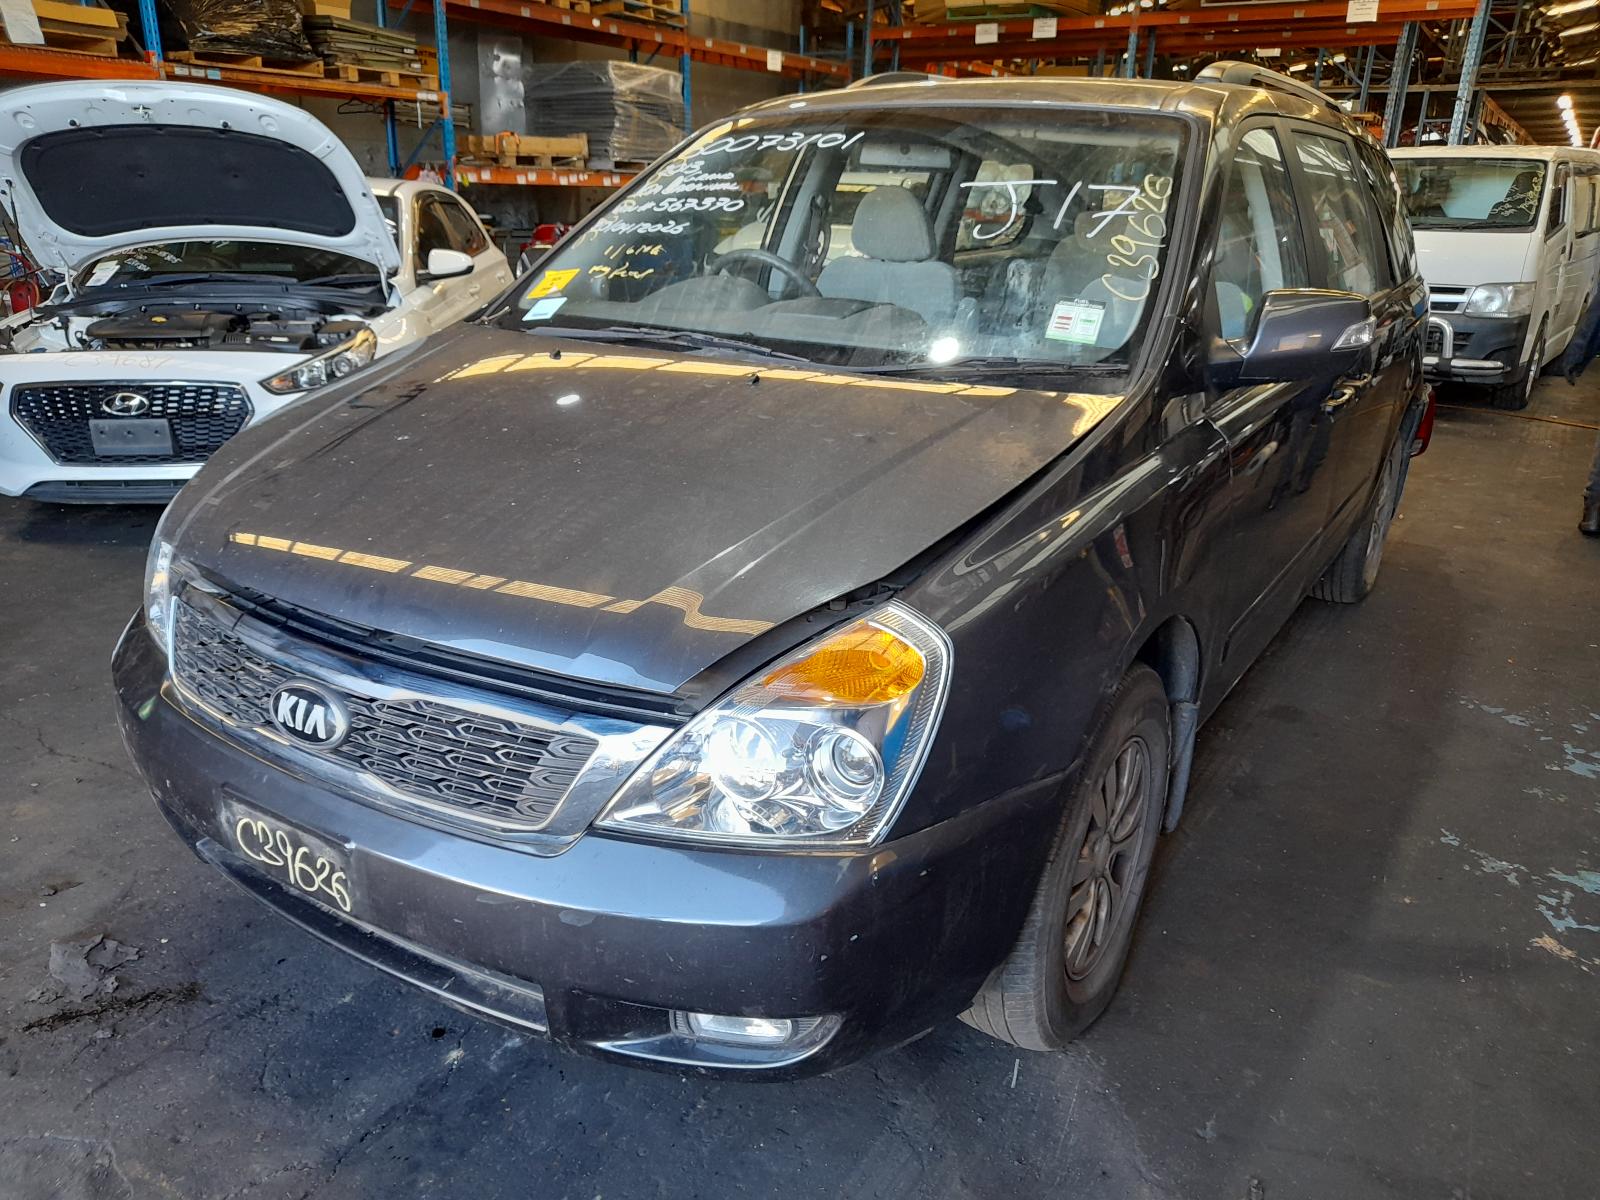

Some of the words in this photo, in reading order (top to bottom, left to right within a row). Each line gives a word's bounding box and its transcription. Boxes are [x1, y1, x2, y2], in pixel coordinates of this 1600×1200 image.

[1102, 173, 1174, 301] C39626
[277, 691, 327, 740] KIA
[236, 817, 351, 912] C39626
